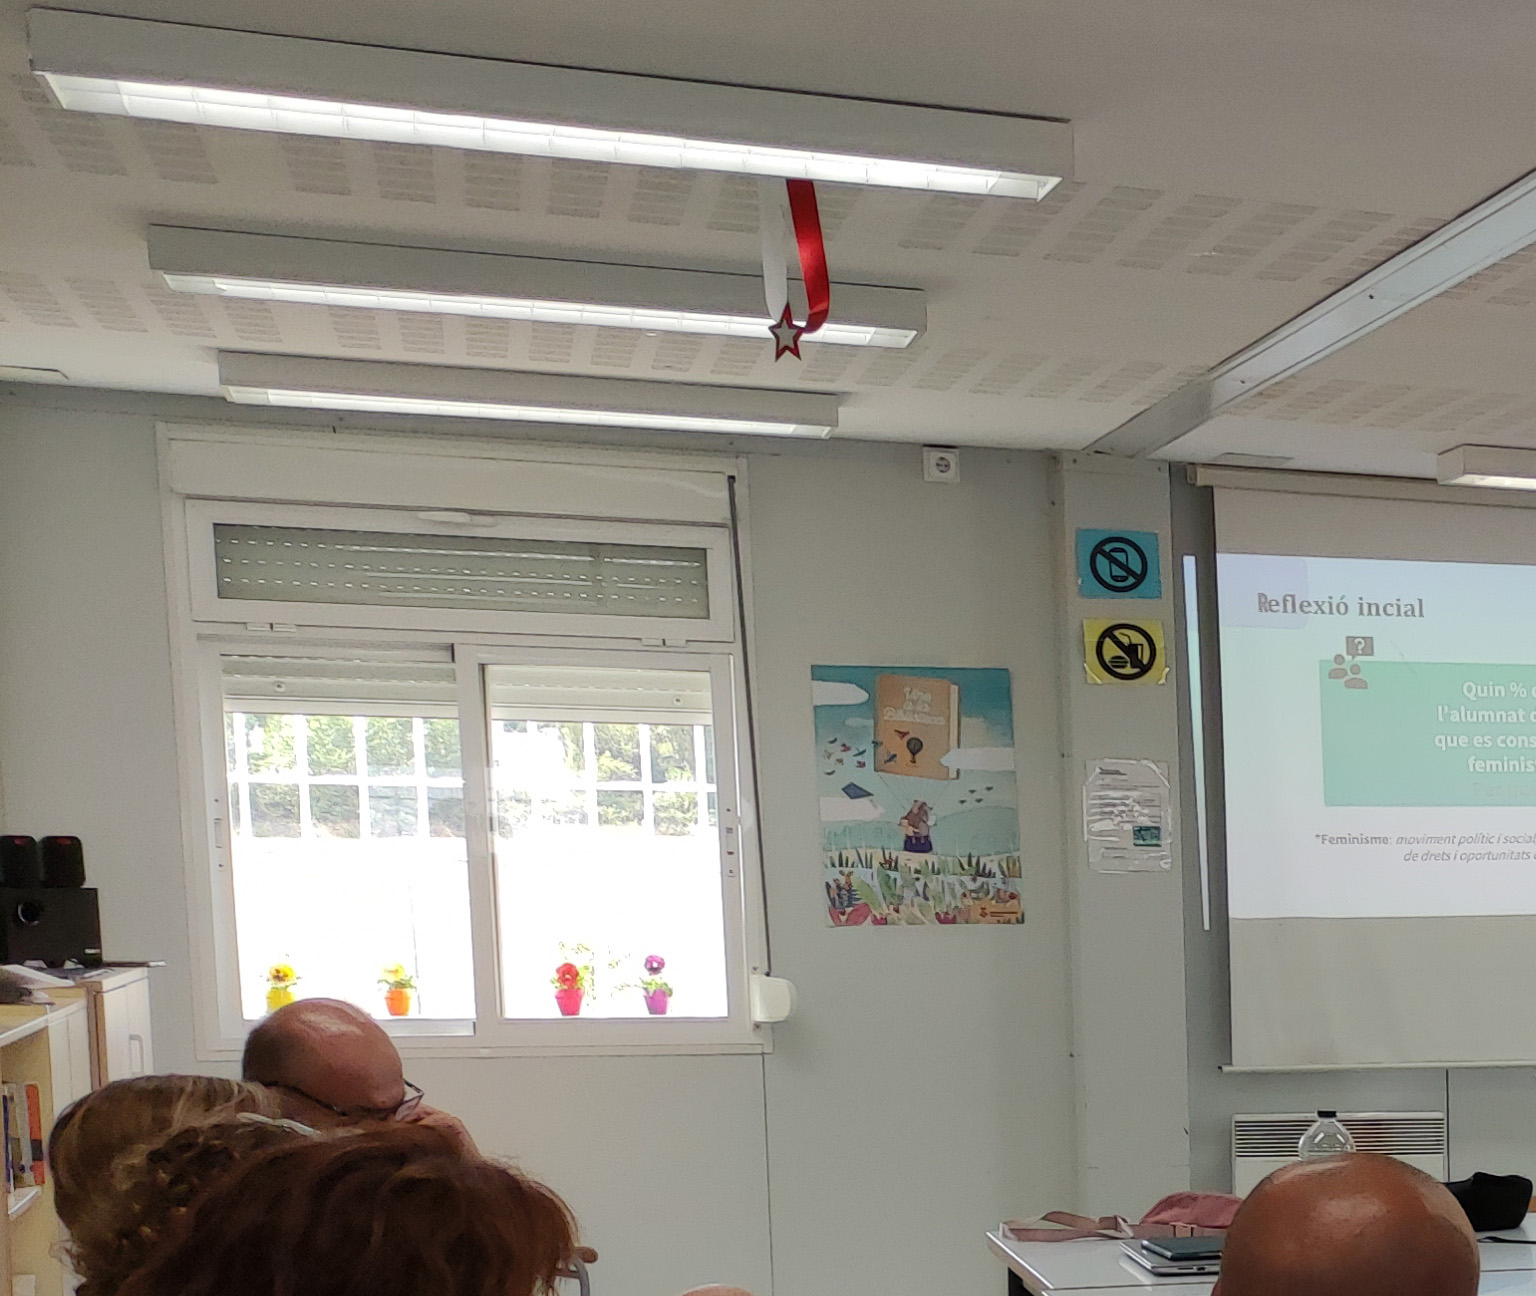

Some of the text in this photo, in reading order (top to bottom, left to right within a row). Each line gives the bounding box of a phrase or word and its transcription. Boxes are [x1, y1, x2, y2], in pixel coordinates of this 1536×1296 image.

[1257, 592, 1425, 618] Reflexió incial
[1462, 681, 1506, 701] Quin
[1509, 681, 1528, 698] %
[1434, 733, 1469, 751] que
[1472, 734, 1493, 748] es
[1395, 834, 1457, 846] moviment
[1403, 850, 1420, 862] de
[1420, 850, 1451, 862] drets
[1459, 850, 1531, 864] oportunitats
